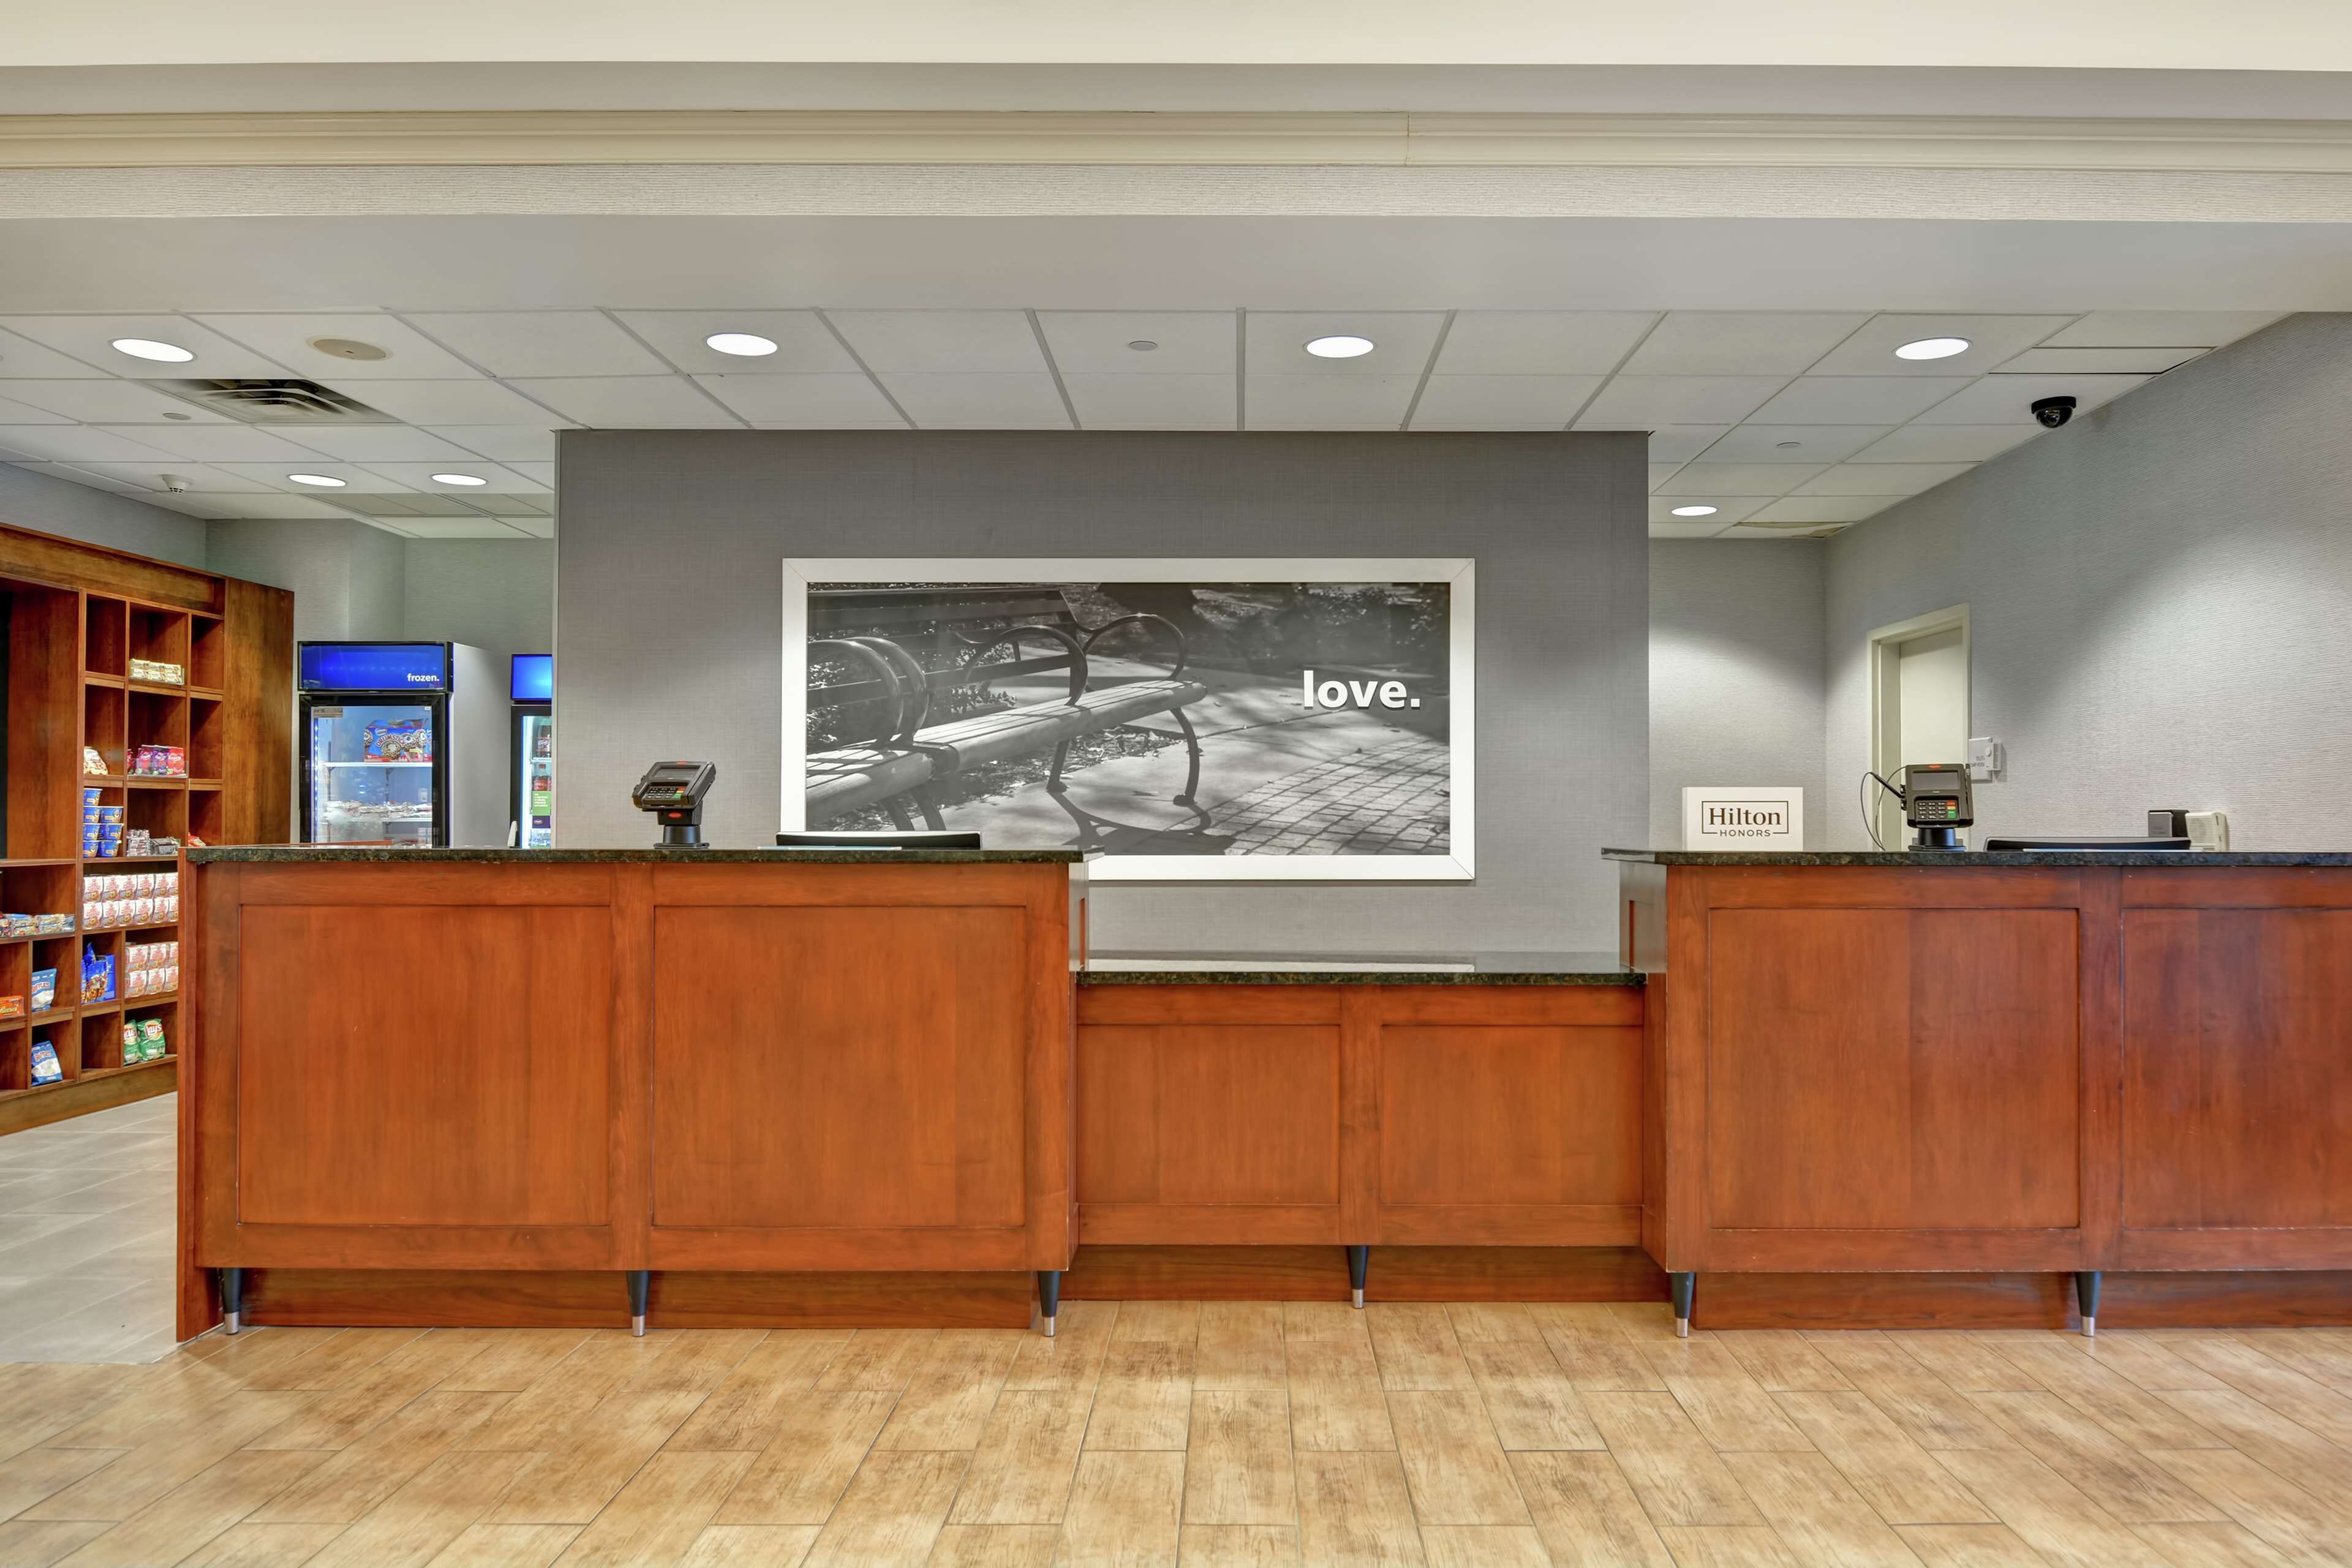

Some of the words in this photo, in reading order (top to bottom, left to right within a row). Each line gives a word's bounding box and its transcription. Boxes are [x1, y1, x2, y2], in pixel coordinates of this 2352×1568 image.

[407, 673, 440, 682] frozen.
[1303, 670, 1420, 709] love.
[375, 734, 405, 747] DRUMSTICK
[1709, 808, 1782, 826] Hilton
